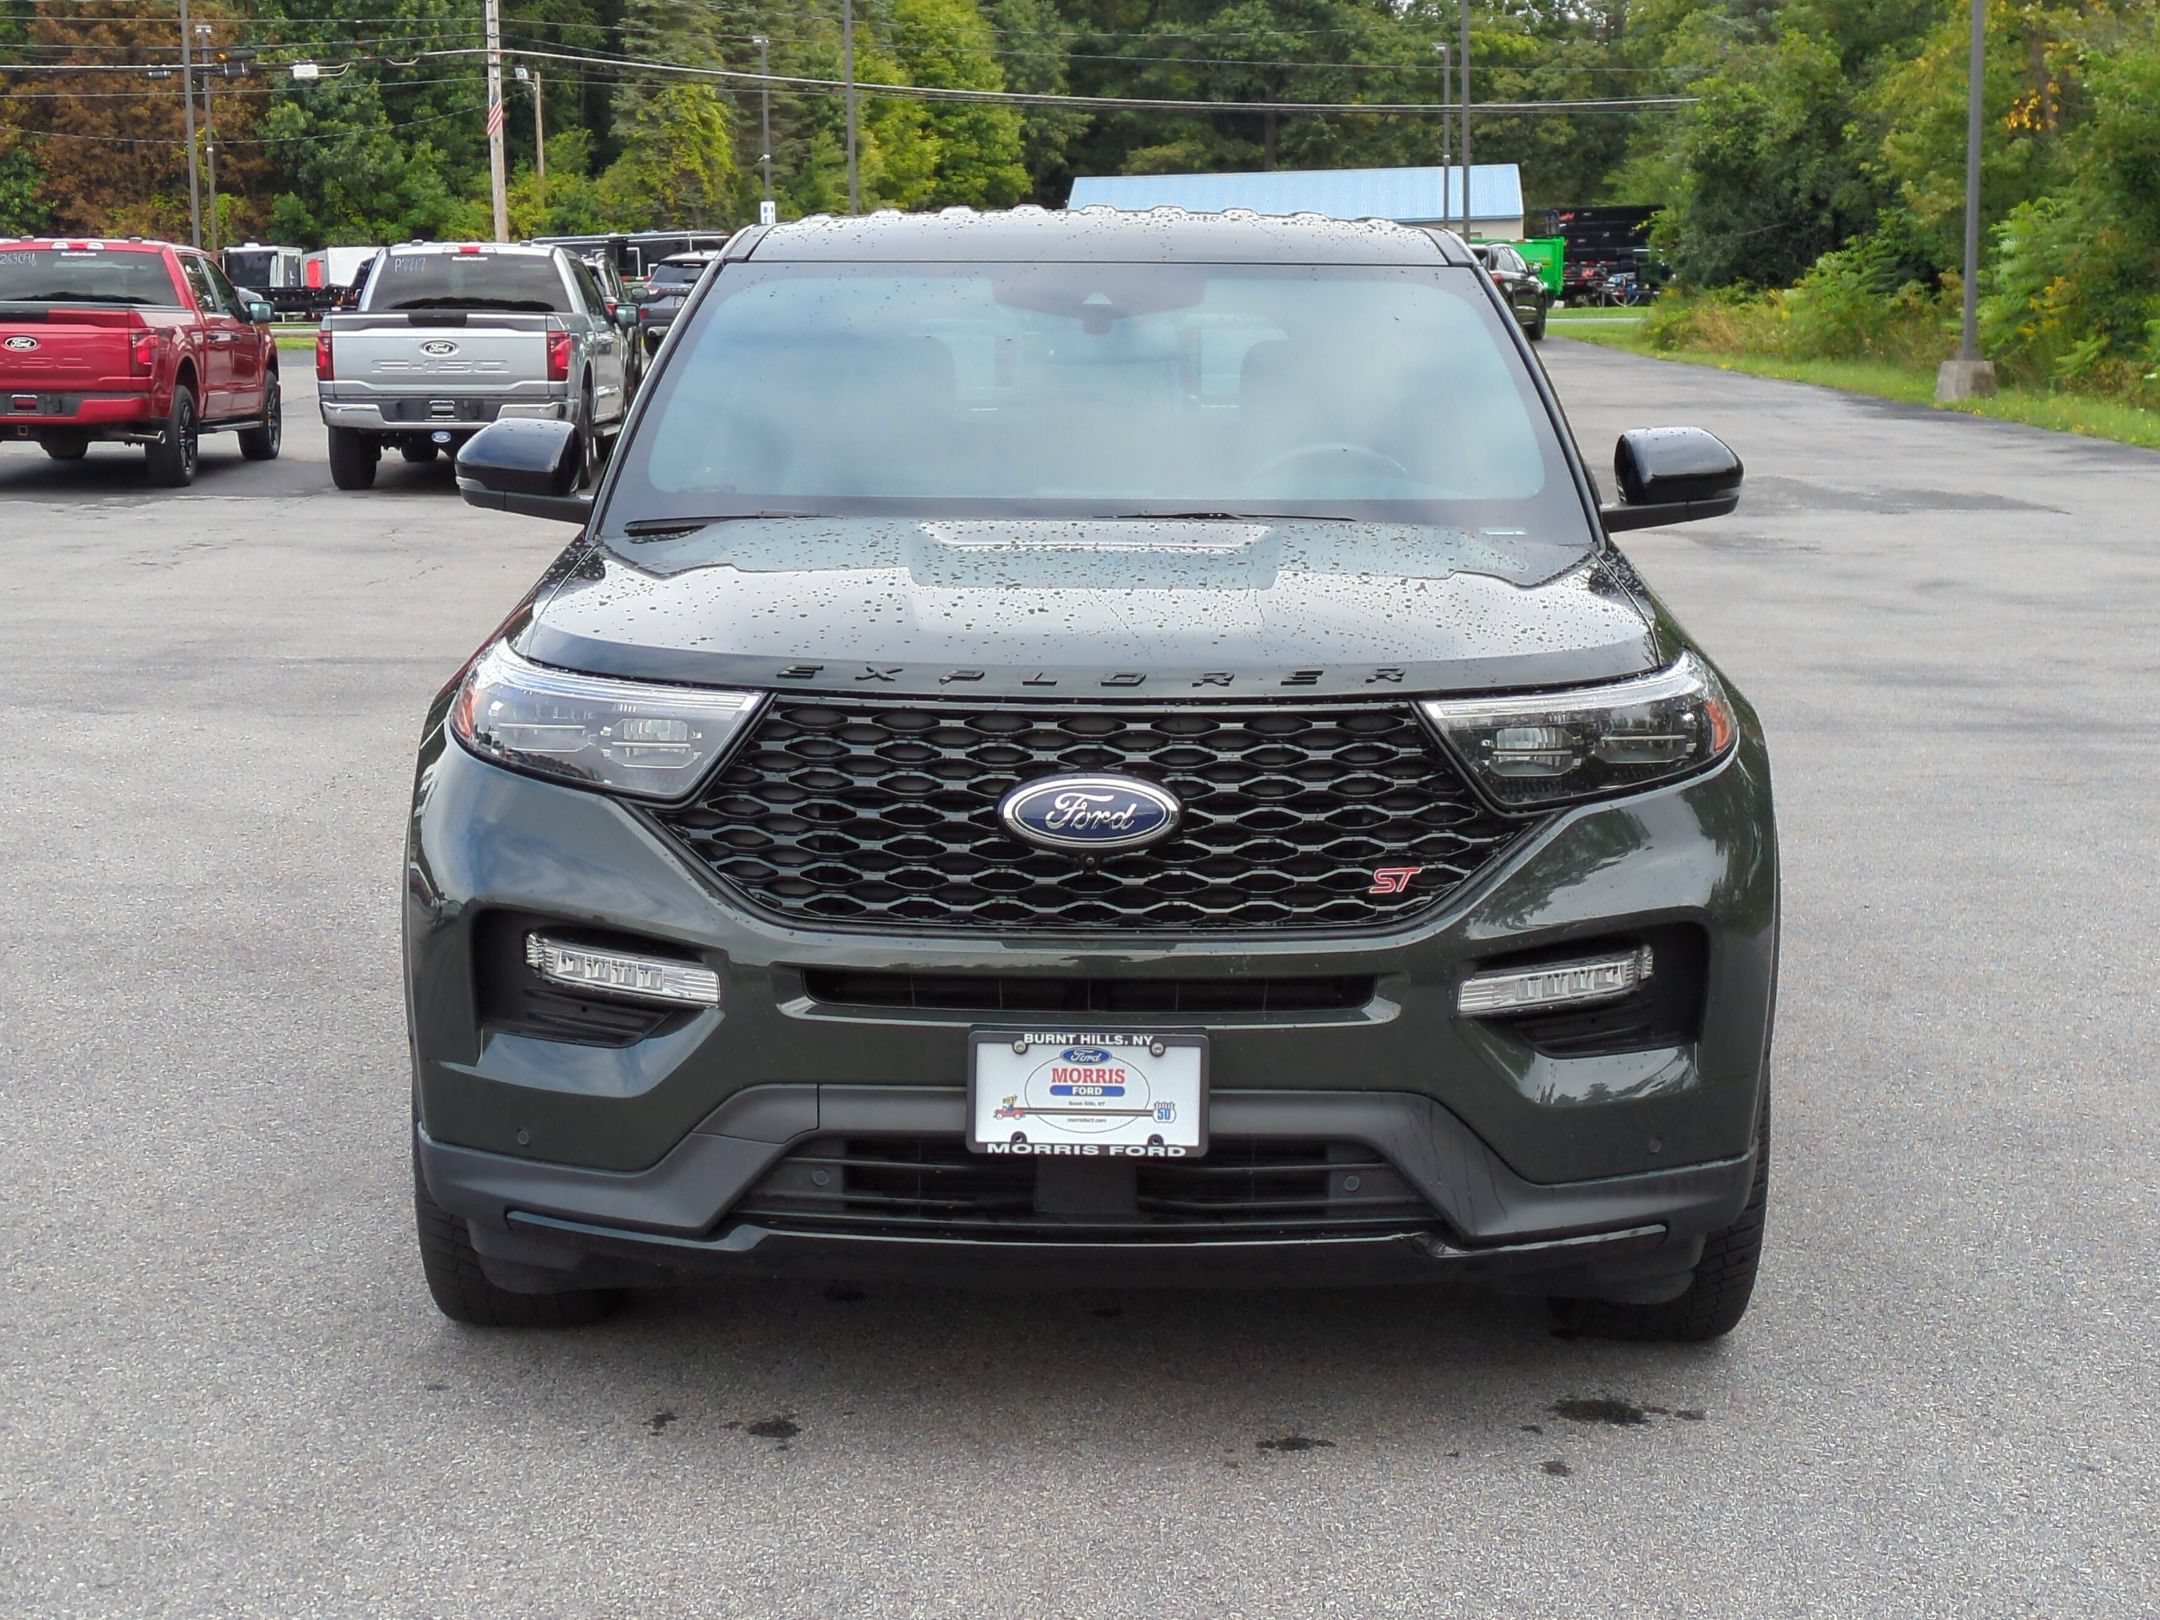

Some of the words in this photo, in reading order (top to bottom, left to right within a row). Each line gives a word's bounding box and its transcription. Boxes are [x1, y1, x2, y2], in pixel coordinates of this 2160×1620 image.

[428, 342, 450, 353] Ford
[776, 663, 1406, 687] EXPLORER
[1045, 792, 1137, 830] Ford
[1369, 866, 1422, 894] ST
[1023, 1032, 1076, 1045] BURNT
[1132, 1035, 1154, 1046] NY
[1070, 1049, 1103, 1063] Ford
[1052, 1067, 1126, 1084] MORRIS
[1072, 1086, 1103, 1096] FORD
[986, 1143, 1100, 1156] MORRIS
[1109, 1145, 1187, 1158] FORD
